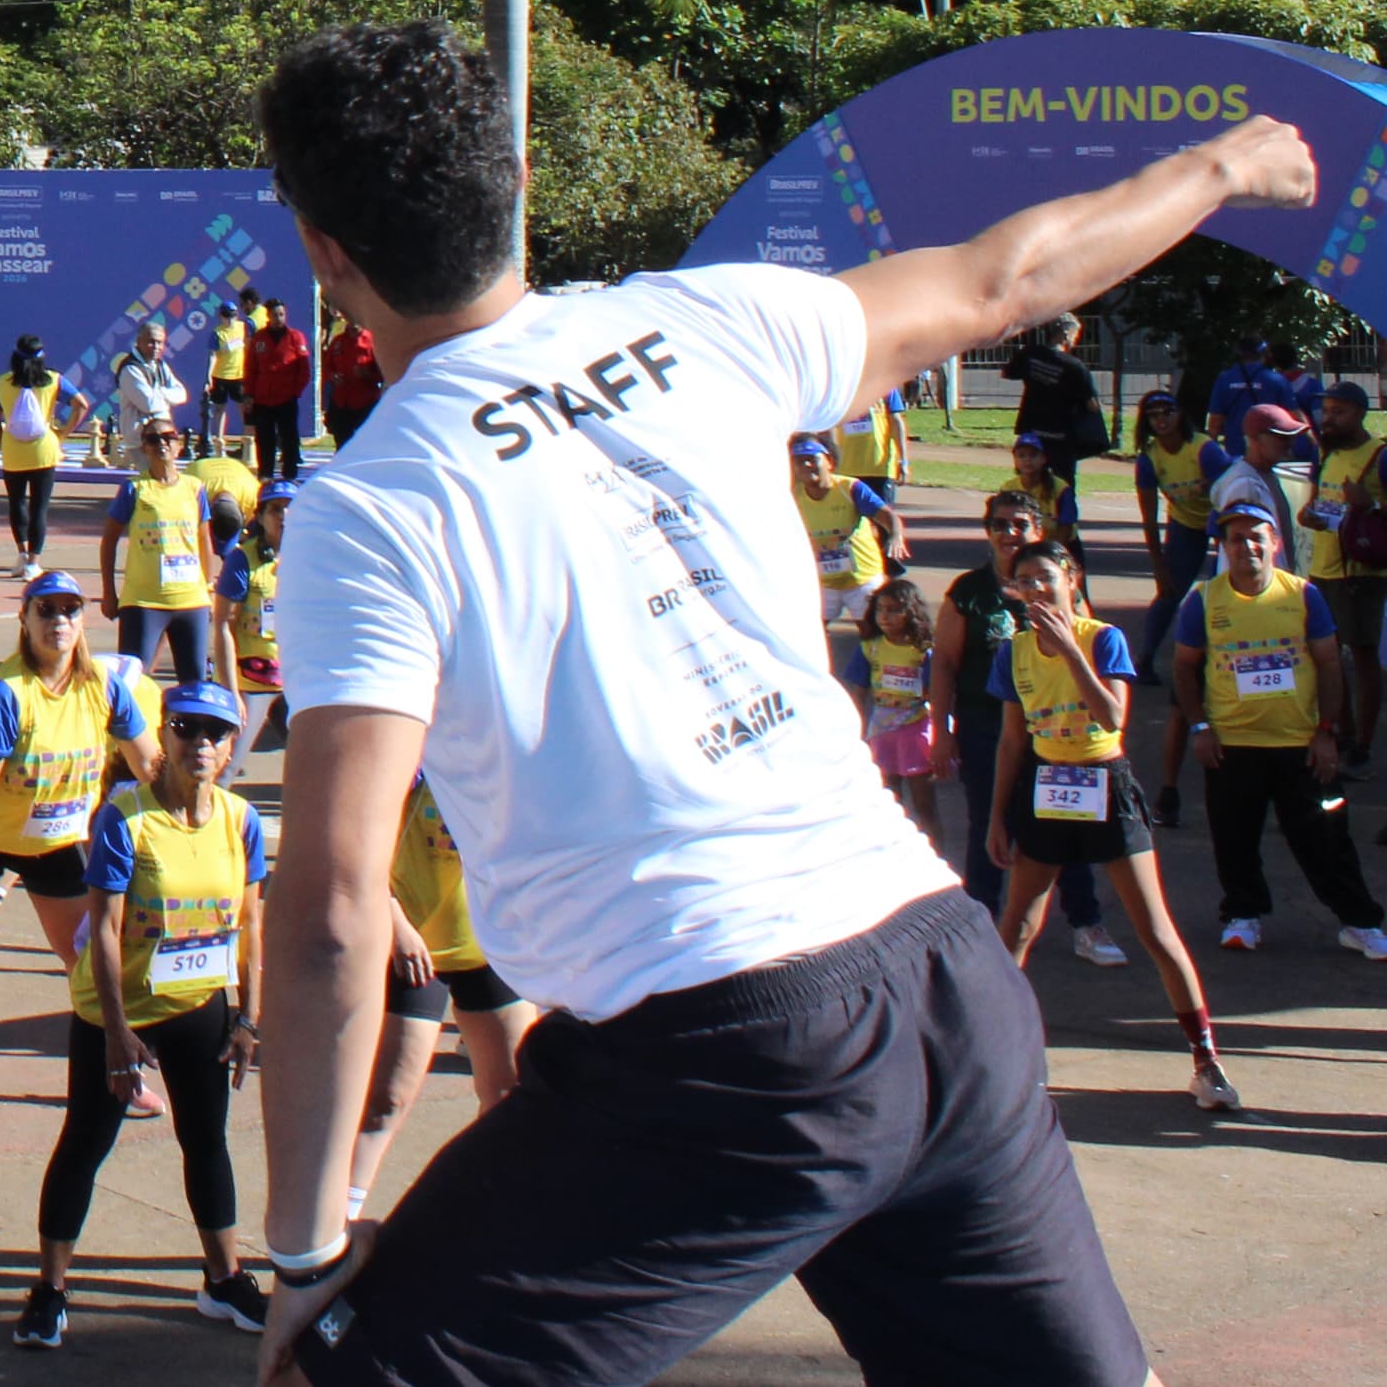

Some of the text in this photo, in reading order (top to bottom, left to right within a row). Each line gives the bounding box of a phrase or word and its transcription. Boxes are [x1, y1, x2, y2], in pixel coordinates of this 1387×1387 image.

[951, 84, 1249, 123] BEM-VINDOS
[767, 225, 819, 240] Festival
[756, 241, 826, 264] Vamos
[471, 330, 678, 462] STAFF
[1252, 672, 1282, 687] 428
[1047, 788, 1081, 804] 342
[173, 952, 208, 972] 510
